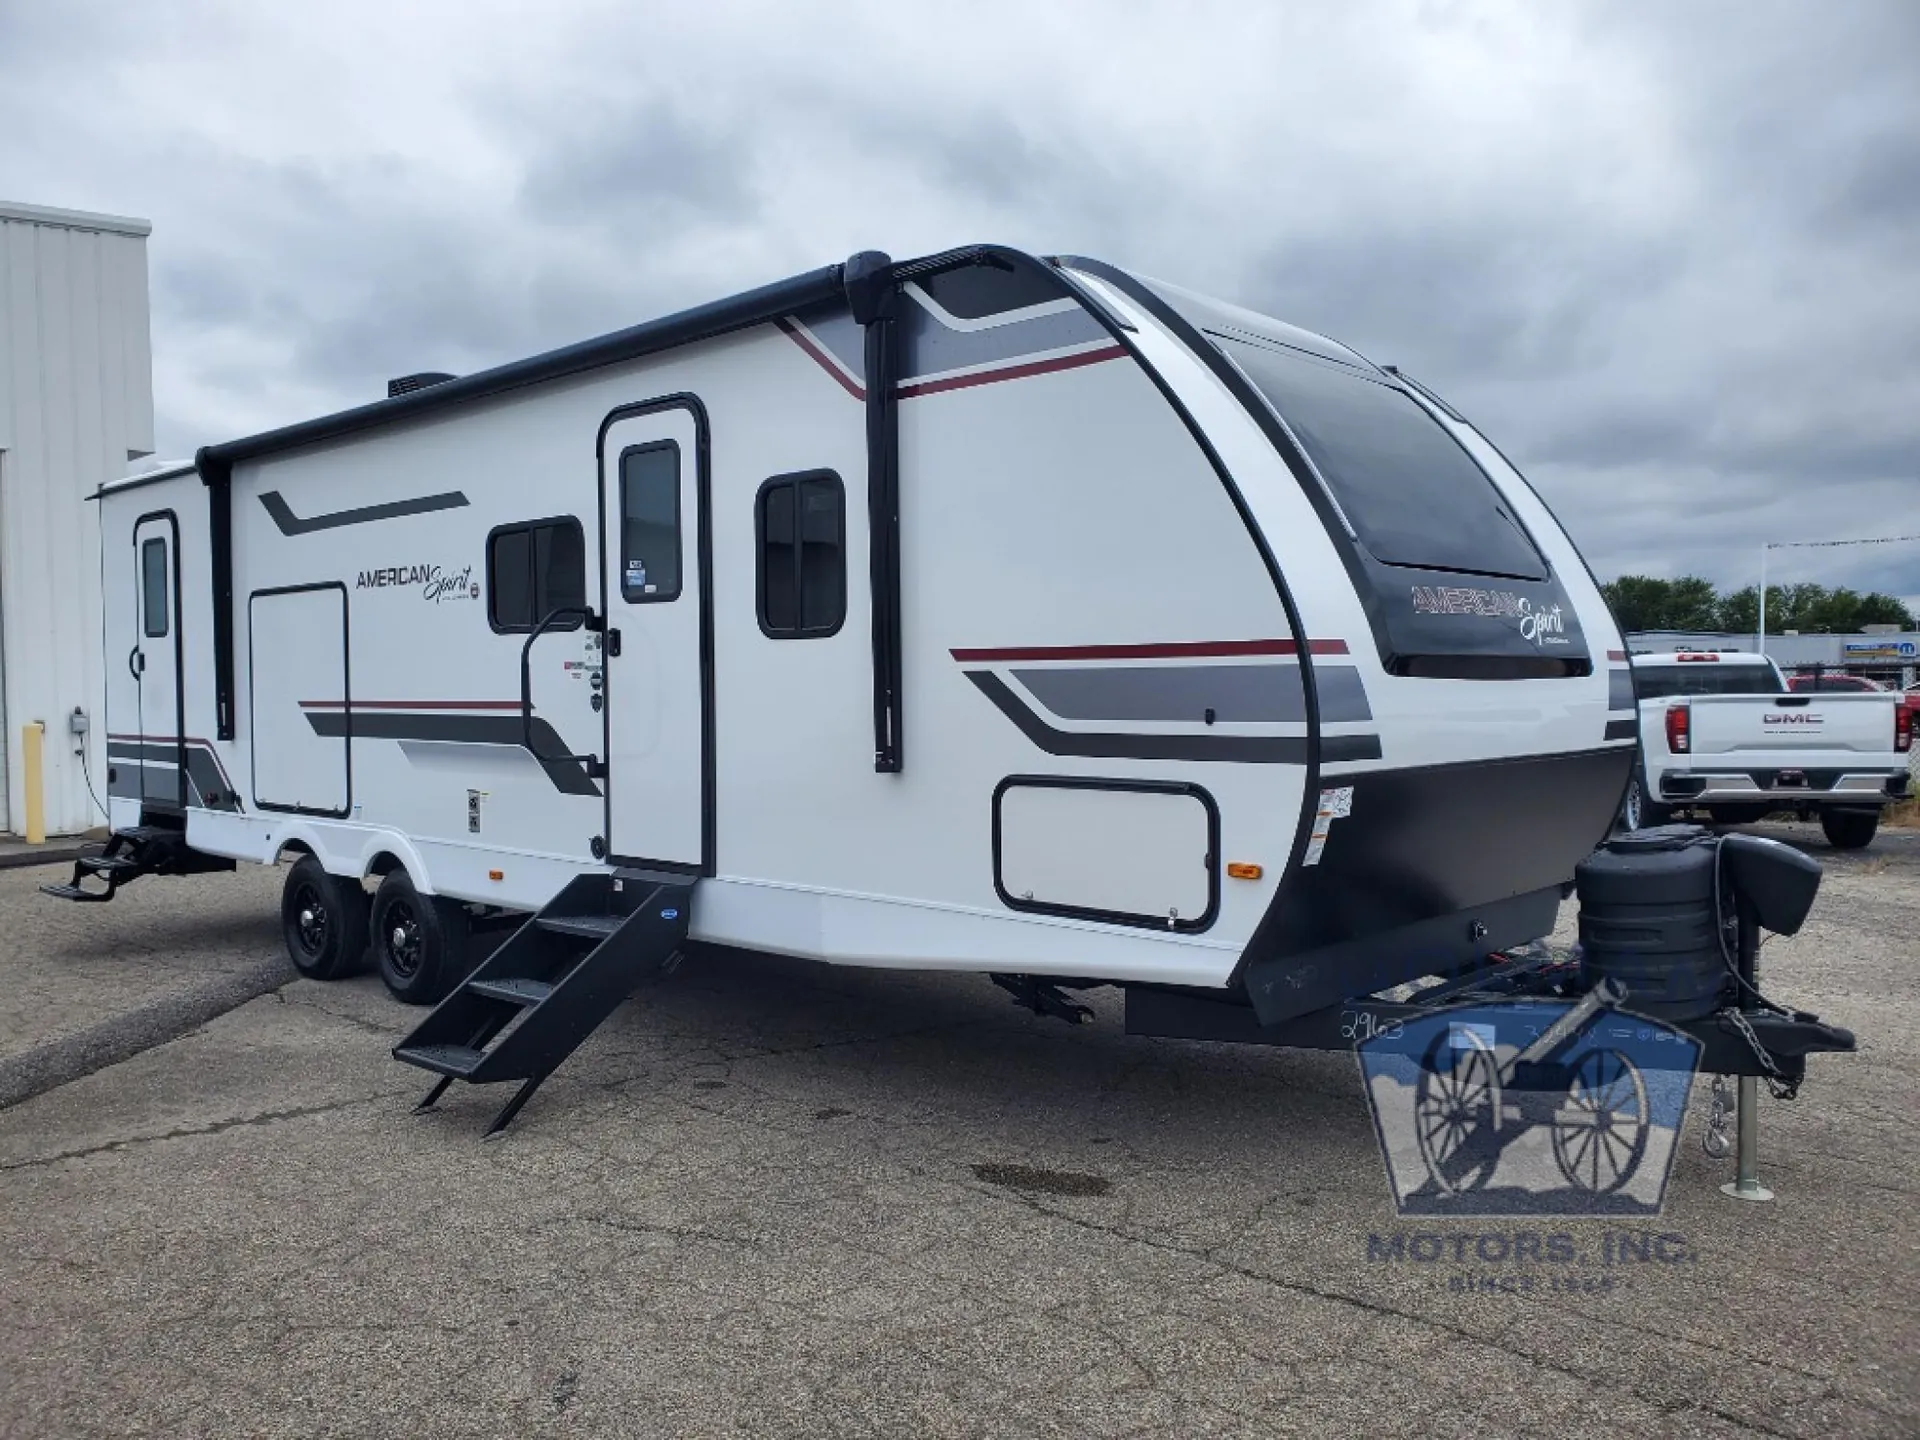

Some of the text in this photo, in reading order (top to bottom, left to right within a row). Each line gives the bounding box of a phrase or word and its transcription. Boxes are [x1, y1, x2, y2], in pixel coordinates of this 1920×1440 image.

[423, 564, 471, 605] Spirit
[1518, 596, 1564, 645] Spirit
[1763, 713, 1823, 725] GMC
